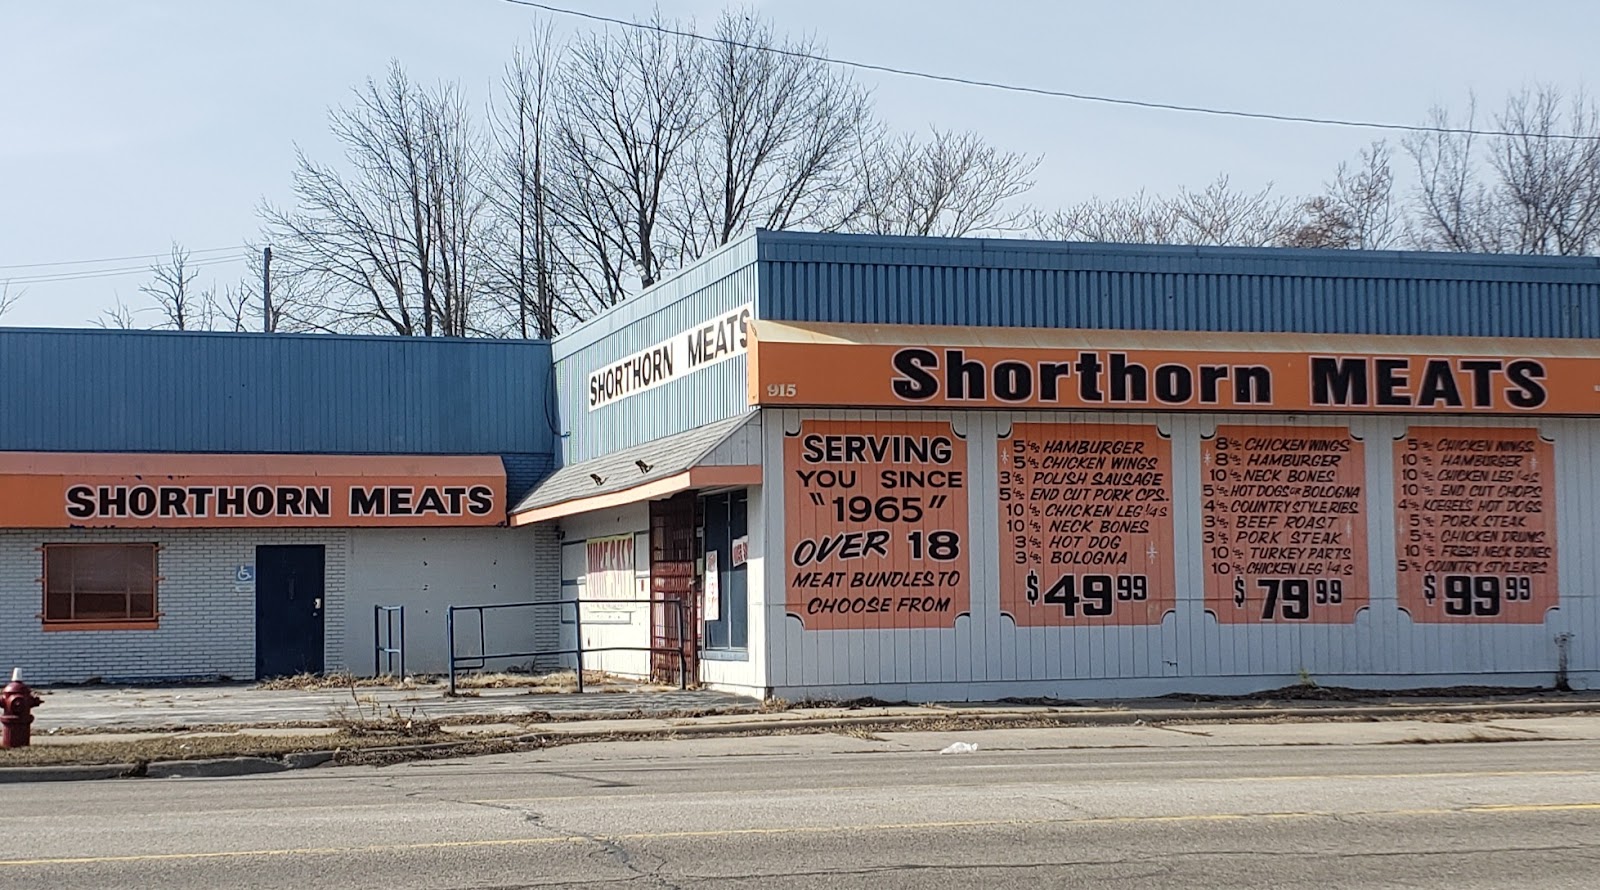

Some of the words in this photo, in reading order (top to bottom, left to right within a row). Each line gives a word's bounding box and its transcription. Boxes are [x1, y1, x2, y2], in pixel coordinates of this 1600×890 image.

[590, 342, 673, 406] SHORTHORN
[687, 308, 750, 368] MEATS
[891, 347, 1273, 404] Shorthorn
[1309, 355, 1548, 409] MEATS
[767, 384, 797, 397] 915
[802, 433, 952, 464] SERVING
[1013, 440, 1026, 453] 5
[1043, 440, 1144, 454] HAMBURGER
[1216, 437, 1228, 450] 8
[1245, 437, 1305, 451] CHICKEN
[1309, 439, 1350, 452] WINGS
[1407, 439, 1418, 451] 5
[1437, 438, 1492, 451] CHICKEN
[1013, 456, 1026, 468] 5
[1042, 456, 1105, 470] CHICKEN
[1111, 457, 1158, 470] WINGS
[1215, 453, 1228, 466] 8
[1247, 454, 1341, 467] HAMBURGER
[1402, 454, 1417, 466] 10
[1441, 455, 1524, 467] HAMBURGER
[796, 470, 856, 488] YOU
[881, 470, 963, 489] SINCE
[1000, 471, 1010, 484] 3
[1033, 471, 1087, 485] POLISH
[1091, 473, 1163, 486] SAUSAGE
[1210, 469, 1226, 481] 10
[1244, 470, 1281, 481] NECK
[1287, 470, 1335, 482] BONES
[1402, 469, 1417, 481] 10
[1437, 469, 1489, 482] CHICKEN
[1491, 471, 1514, 482] LEG
[999, 488, 1010, 501] 5
[1030, 488, 1059, 500] END
[1063, 488, 1091, 500] CUT
[1093, 489, 1133, 501] PORK
[1203, 485, 1214, 497] 5
[1230, 485, 1256, 497] HOT
[1256, 485, 1289, 497] DOGS
[1302, 486, 1360, 498] BOLOGNA
[1402, 484, 1418, 496] 10
[1440, 484, 1465, 496] END
[1469, 485, 1495, 497] CUT
[1497, 486, 1542, 498] CHOPS
[66, 484, 330, 518] SHORTHORN
[349, 485, 494, 517] MEATS
[1204, 500, 1215, 513] 4
[1231, 500, 1290, 513] COUNTRY
[1291, 501, 1329, 513] STYLE
[1330, 502, 1359, 514] RIBS
[1398, 499, 1407, 510] 4
[1477, 500, 1504, 512] HOT
[1506, 500, 1542, 513] DOGS
[1006, 503, 1024, 516] 10
[1045, 504, 1114, 517] CHICKEN
[1116, 505, 1143, 517] LEG
[1007, 519, 1024, 532] 10
[1049, 520, 1091, 533] NECK
[1100, 520, 1149, 533] BONES
[1204, 515, 1215, 528] 3
[1236, 515, 1278, 528] BEEF
[1284, 516, 1338, 529] ROAST
[1409, 514, 1420, 527] 5
[1440, 515, 1479, 527] PORK
[1481, 515, 1527, 527] STEAK
[1015, 536, 1026, 548] 3
[1049, 536, 1083, 548] HOT
[1089, 536, 1121, 549] DOG
[1203, 531, 1214, 543] 3
[1235, 531, 1282, 544] PORK
[1290, 531, 1343, 544] STEAK
[1410, 529, 1422, 542] 5
[1441, 530, 1498, 542] CHICKEN
[1502, 531, 1545, 542] DRUMS
[793, 529, 890, 568] OVER
[908, 529, 960, 562] 18
[1211, 546, 1229, 559] 10
[1250, 547, 1306, 560] TURKEY
[1307, 548, 1351, 560] PARTS
[1405, 544, 1420, 557] 10
[1441, 545, 1480, 557] FRESH
[1482, 546, 1512, 558] NECK
[1514, 546, 1552, 558] BONES
[1016, 551, 1027, 564] 3
[1050, 551, 1127, 565] BOLOGNA
[1212, 562, 1230, 574] 10
[1246, 562, 1296, 575] CHICKEN
[1299, 563, 1323, 575] LEG
[1397, 560, 1408, 572] 5
[1424, 560, 1482, 572] COUNTRY
[792, 572, 846, 587] MEAT
[850, 571, 934, 587] BUNDLES
[938, 571, 960, 587] TO
[808, 596, 891, 615] CHOOSE
[897, 597, 951, 612] FROM
